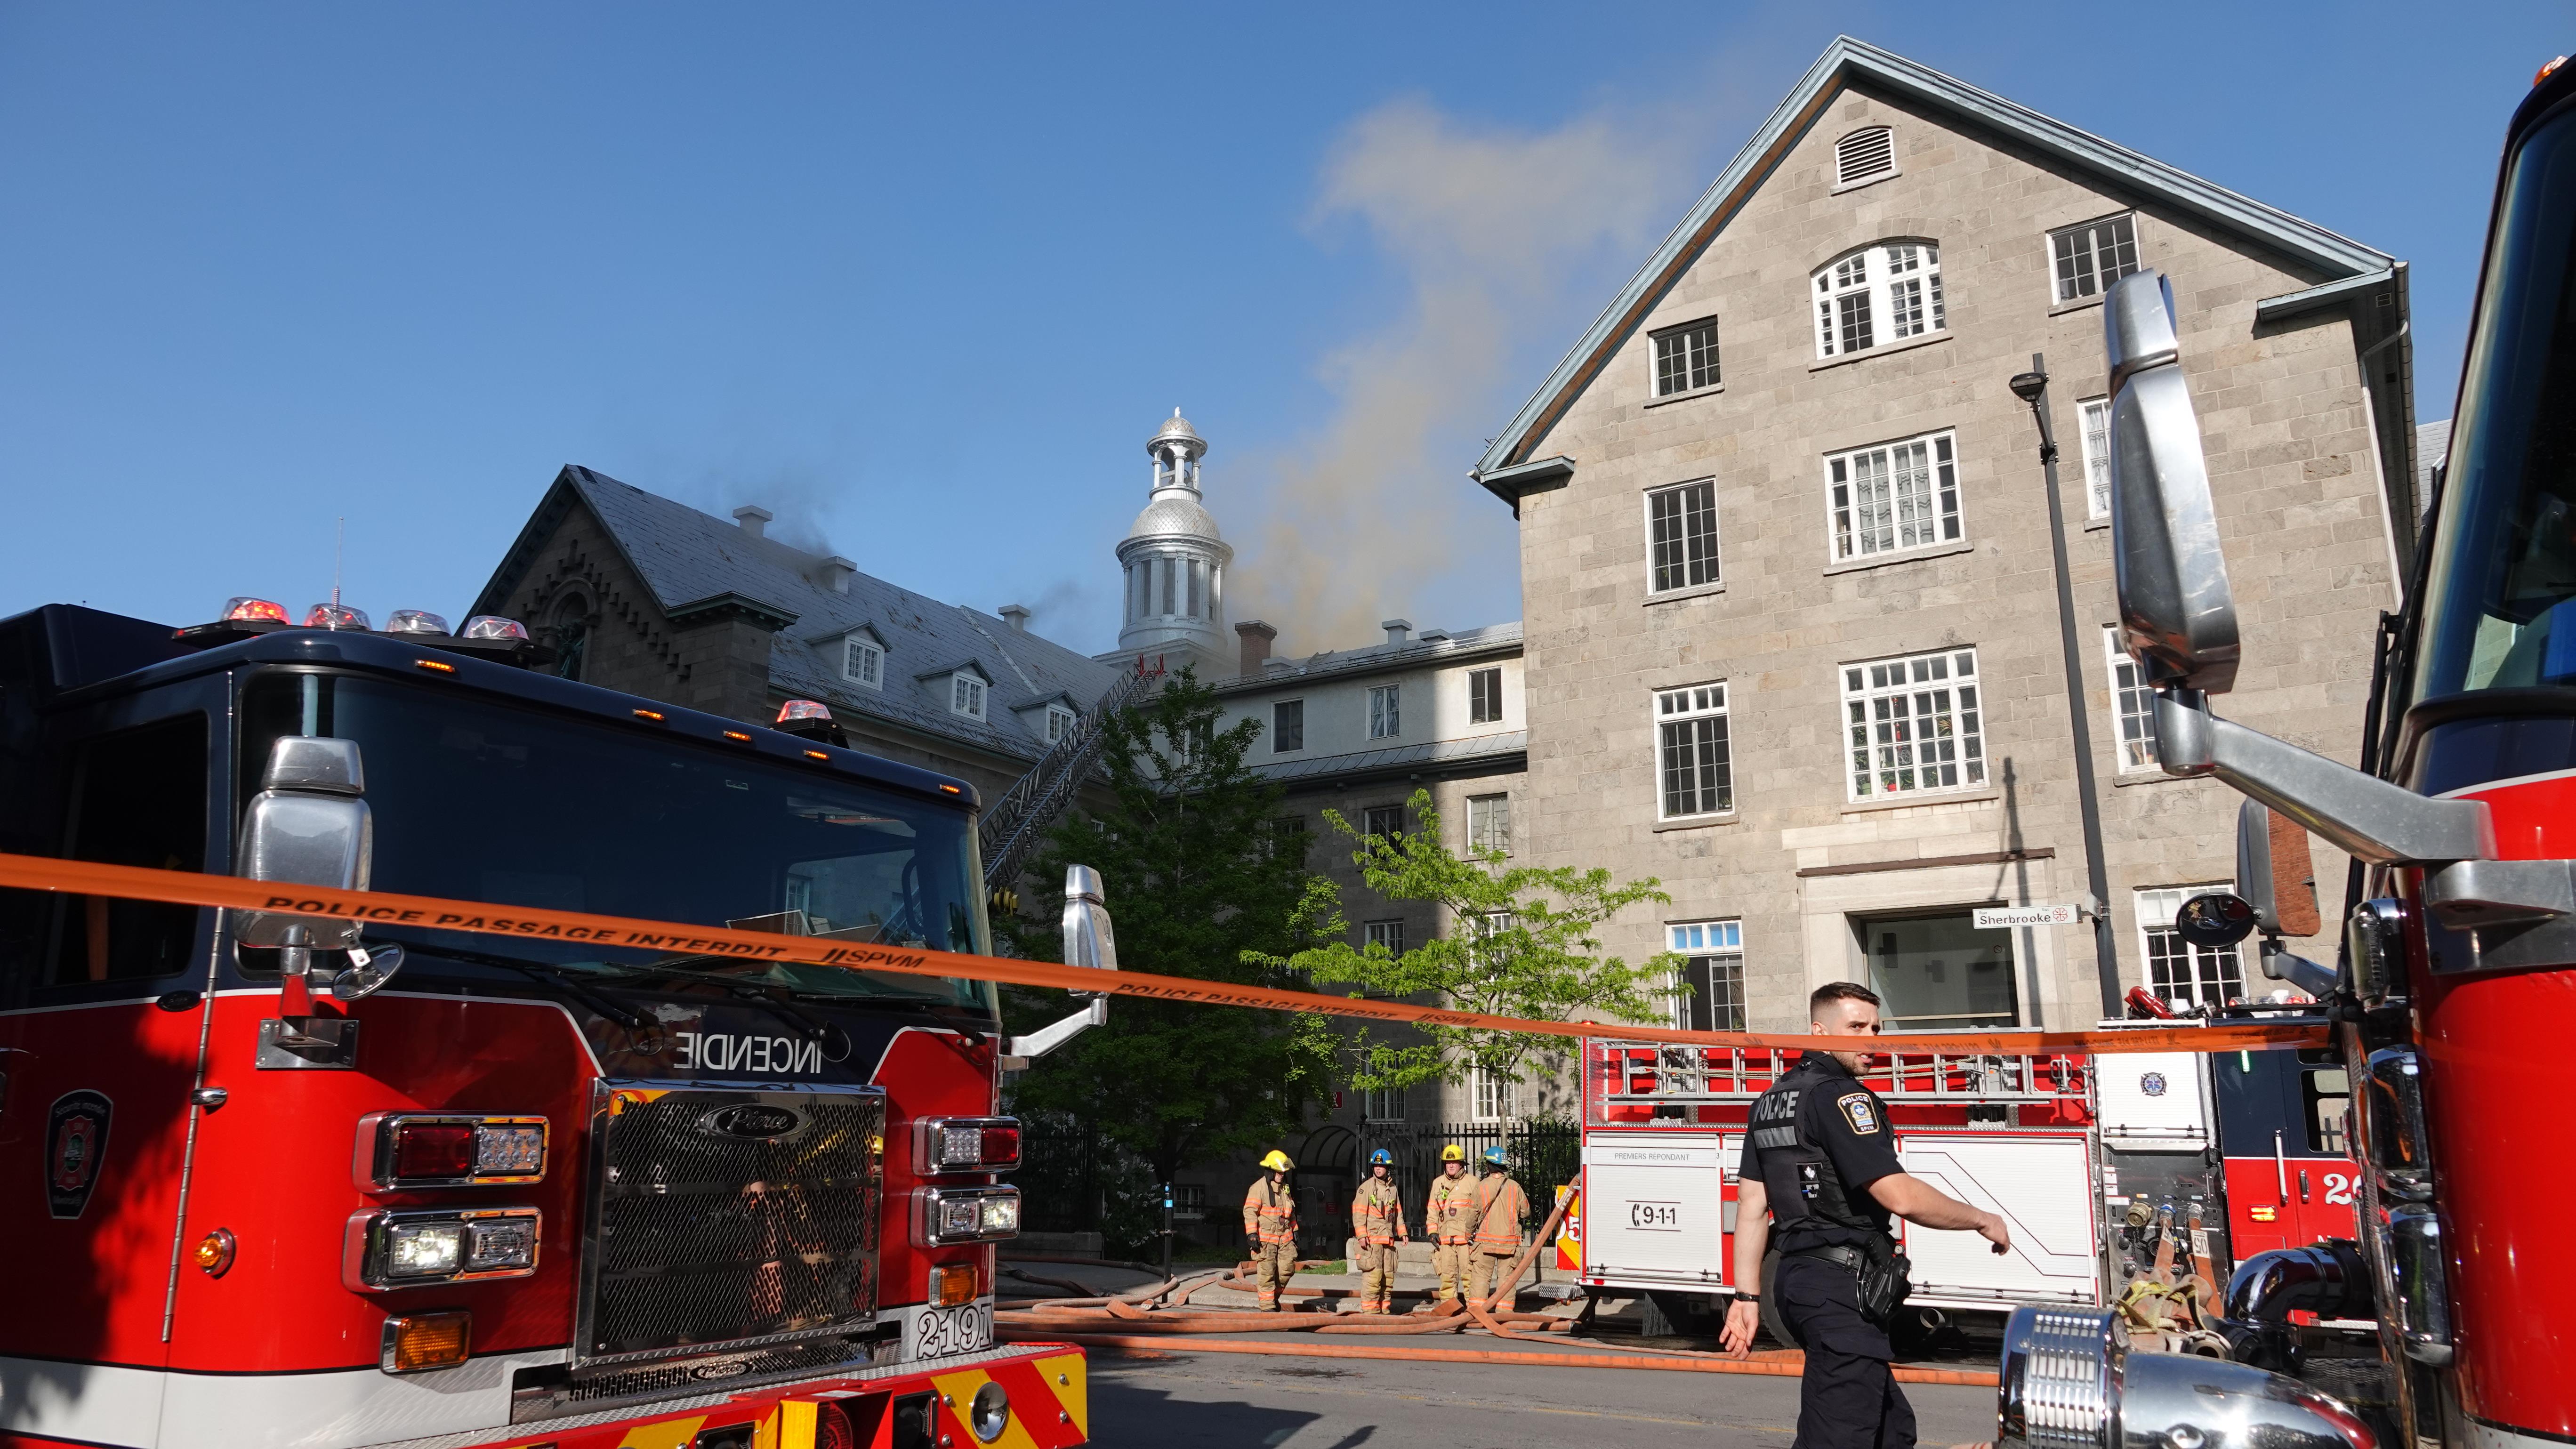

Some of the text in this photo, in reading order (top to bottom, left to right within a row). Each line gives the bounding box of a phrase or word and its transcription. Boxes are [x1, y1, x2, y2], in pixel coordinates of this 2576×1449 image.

[266, 897, 424, 922] POLICE
[436, 914, 620, 941] PASSAGE
[626, 933, 787, 957] INTERDIT
[1980, 913, 2051, 925] Sherbrooke
[1116, 983, 1200, 1001] POLICE
[1205, 993, 1303, 1011] PASSAGE
[1305, 1003, 1398, 1020] INTERDIT
[1755, 1091, 1800, 1122] POLICE
[1841, 1095, 1869, 1106] POLICE
[727, 1107, 789, 1132] Pierce
[1649, 1151, 1690, 1161] RÉPONDANT
[701, 1364, 742, 1377] Pierce
